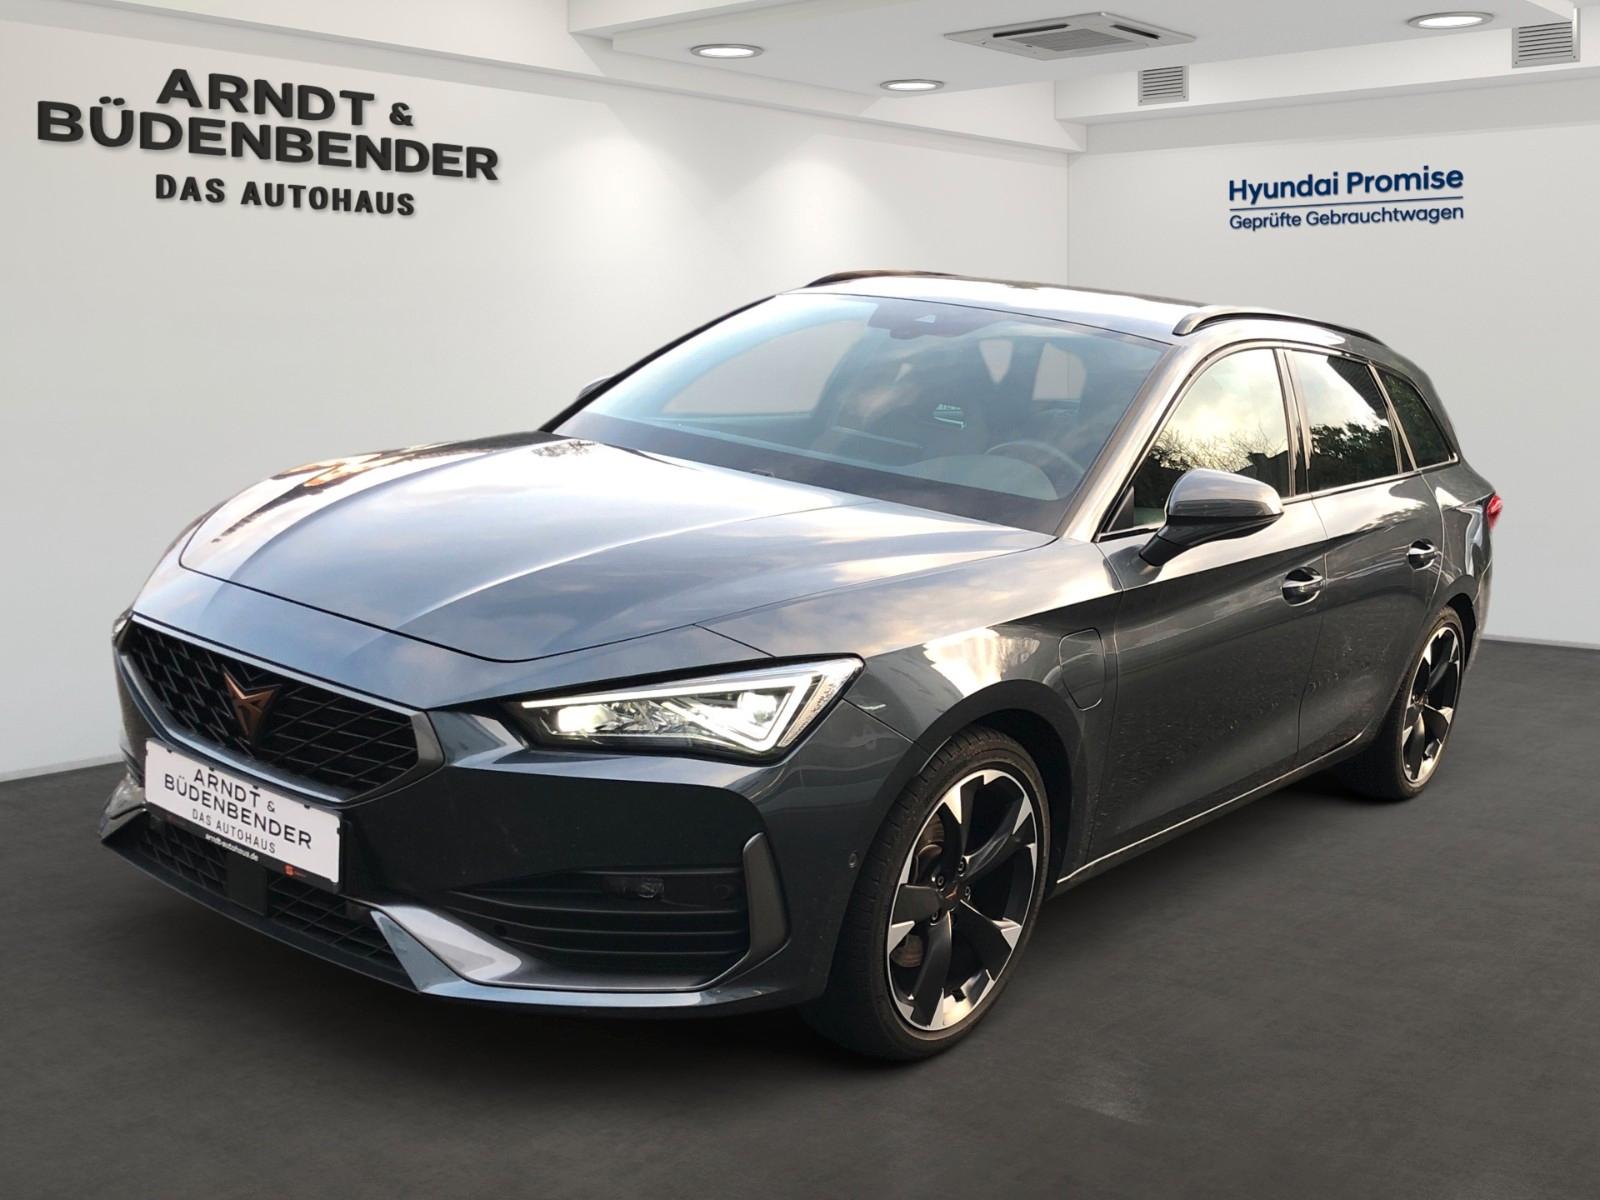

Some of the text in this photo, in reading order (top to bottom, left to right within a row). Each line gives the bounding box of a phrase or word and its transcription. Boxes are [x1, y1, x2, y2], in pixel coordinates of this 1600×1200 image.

[156, 68, 414, 126] ARNDT &
[37, 96, 500, 181] BÜDENBENDER
[155, 174, 416, 216] DAS AUTOHAUS
[1228, 165, 1464, 205] Hyundai Promise
[1229, 205, 1464, 232] Geprüfte Gebrauchtwagen
[164, 773, 312, 850] BÜDENBENDER
[193, 768, 276, 813] ARNDT &
[192, 808, 212, 827] DAS
[216, 820, 276, 855] AUTOHAUS
